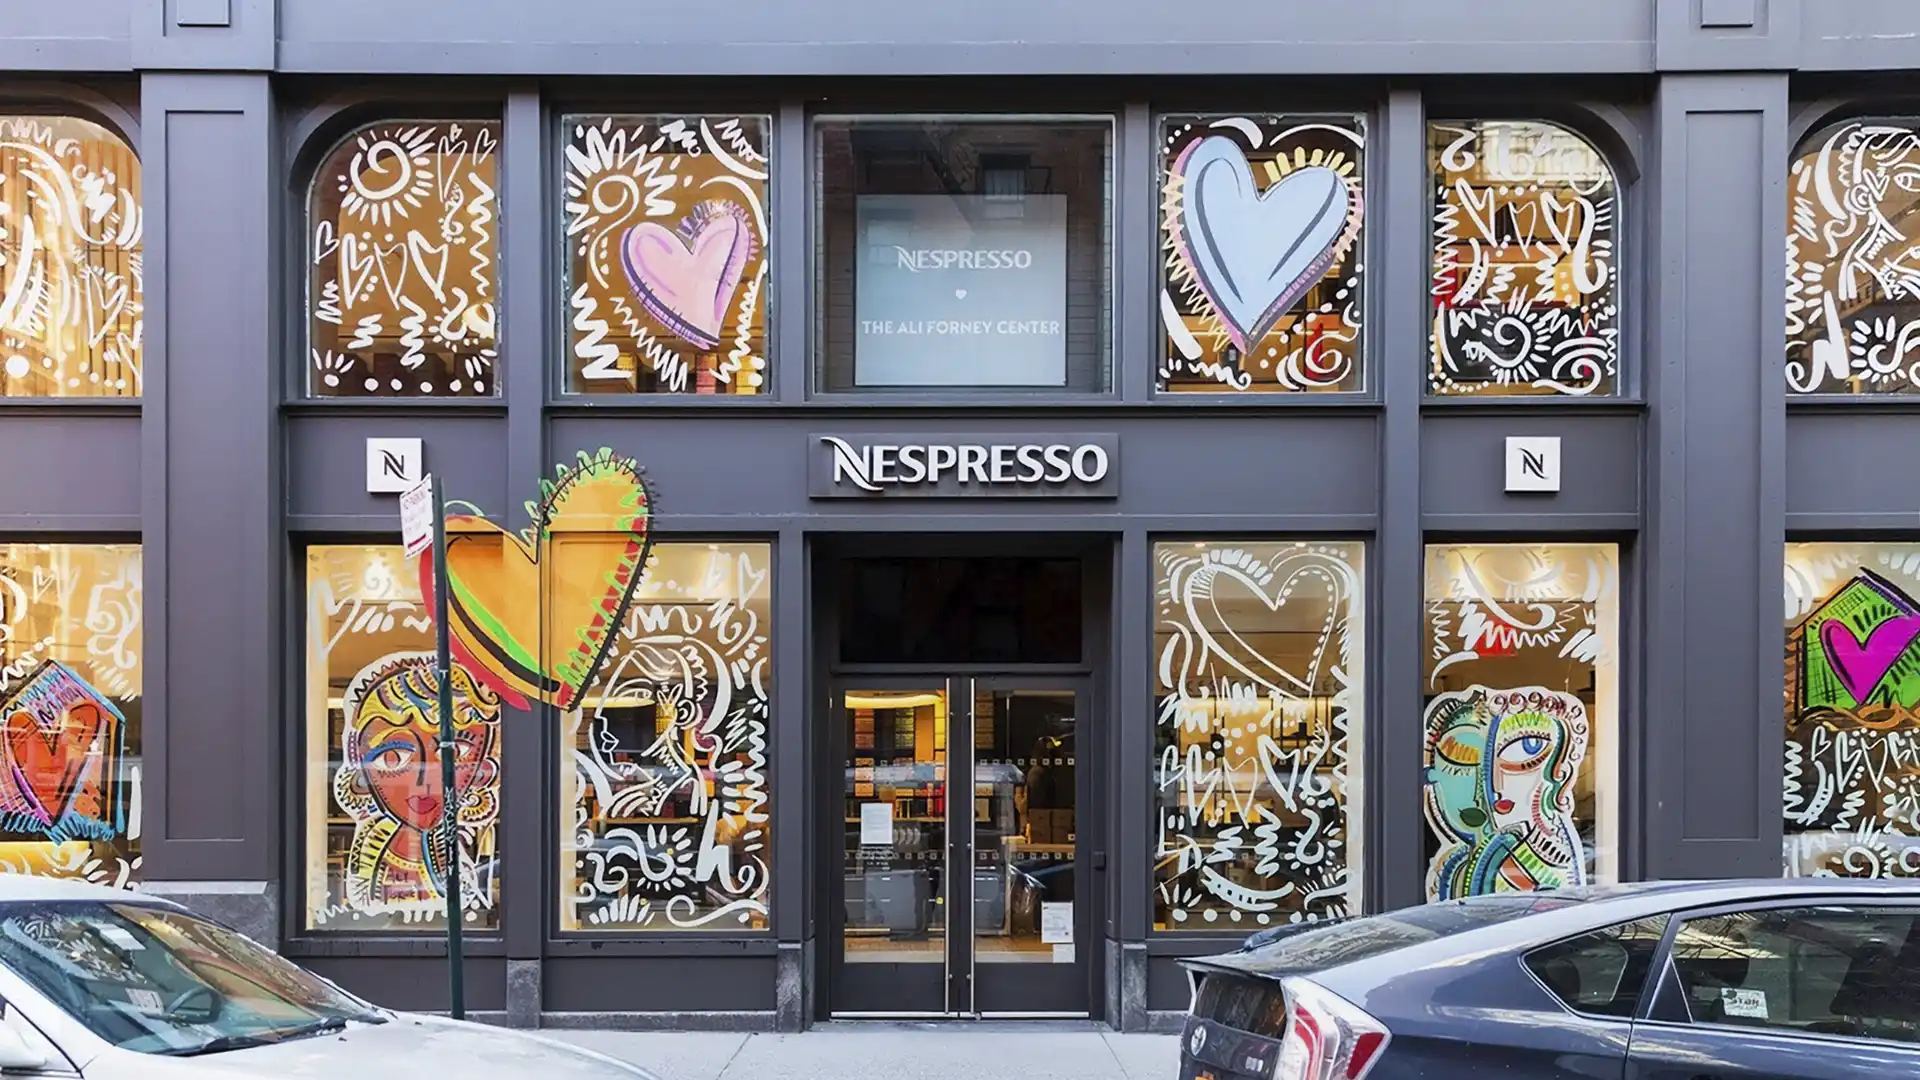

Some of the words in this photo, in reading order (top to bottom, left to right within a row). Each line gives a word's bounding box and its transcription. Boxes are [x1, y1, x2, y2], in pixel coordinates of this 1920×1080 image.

[892, 245, 1032, 272] NESPRESSO
[862, 320, 893, 335] THE
[896, 320, 922, 335] ALI
[926, 320, 992, 335] FORNEY
[996, 320, 1060, 335] CENTER
[378, 449, 411, 481] N
[820, 436, 1108, 491] NESPRESSO
[1517, 447, 1550, 480] N
